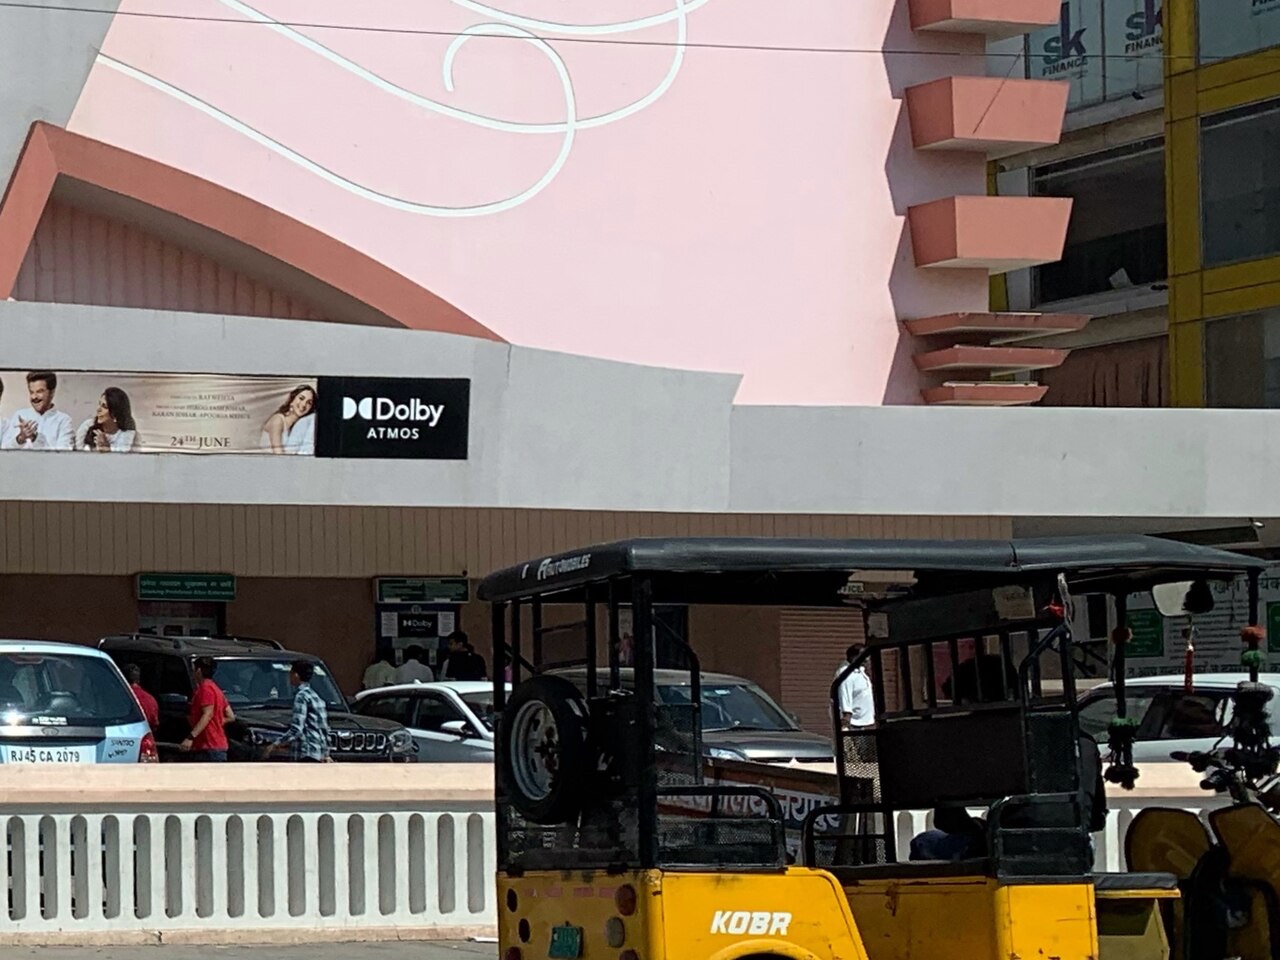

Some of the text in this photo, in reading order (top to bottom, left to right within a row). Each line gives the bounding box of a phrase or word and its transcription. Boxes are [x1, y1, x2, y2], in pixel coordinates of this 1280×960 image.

[1125, 36, 1163, 54] FINAN
[1042, 59, 1089, 77] FINANCE
[376, 397, 444, 427] Dolby
[197, 436, 231, 450] JUNE
[367, 428, 420, 440] ATMOS
[39, 751, 54, 763] CA
[56, 751, 80, 763] 2079
[710, 911, 792, 936] KOBR
